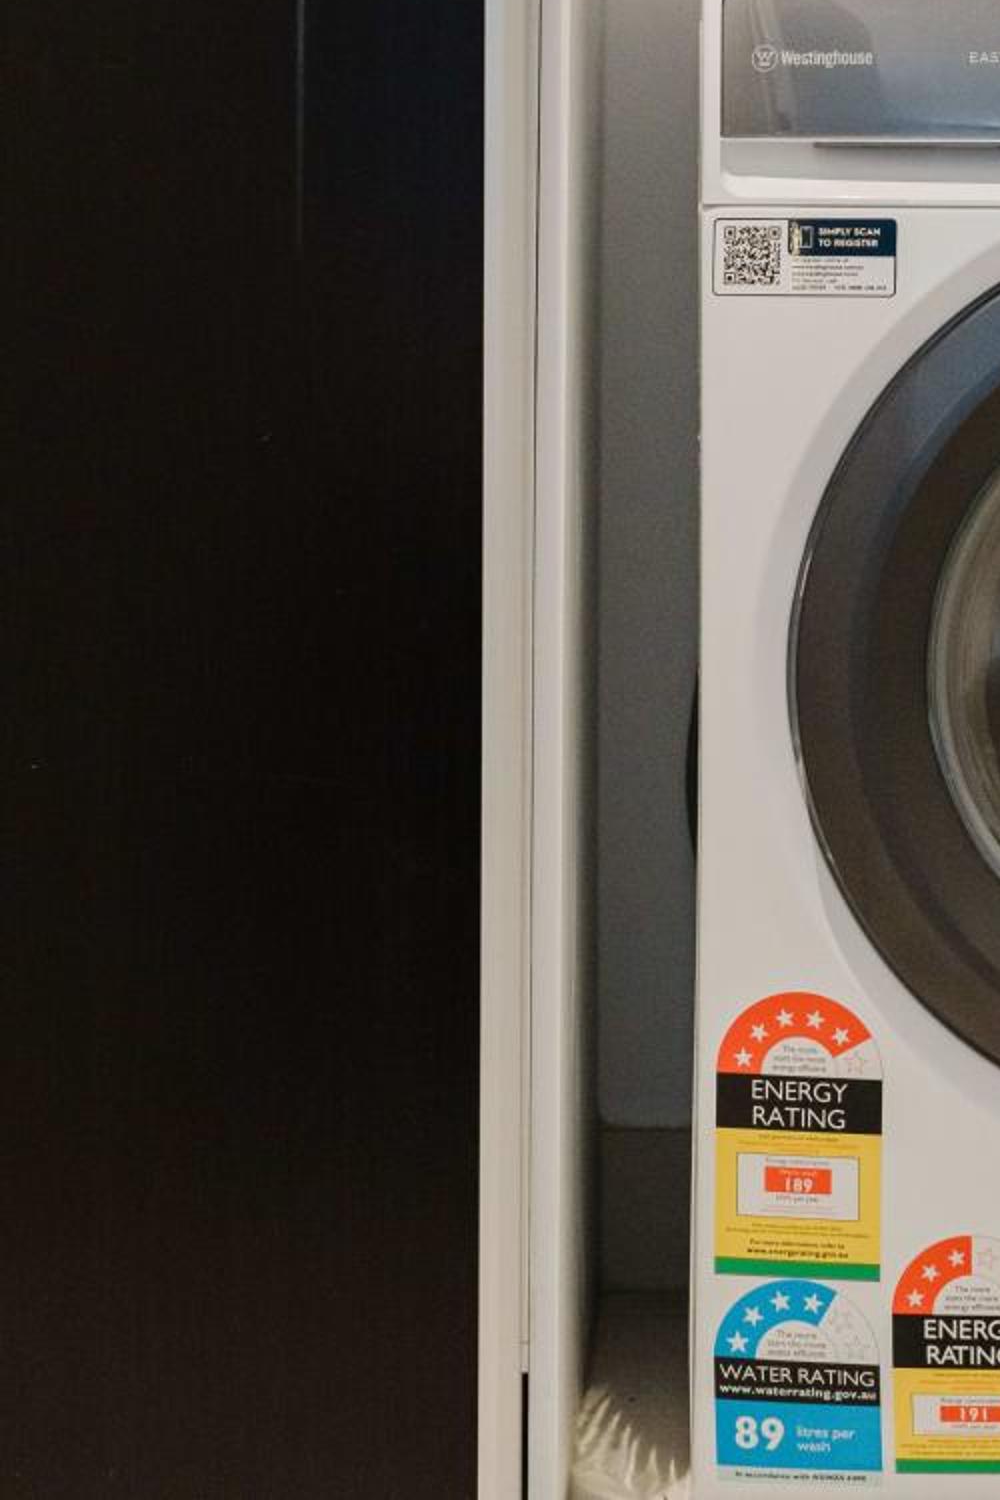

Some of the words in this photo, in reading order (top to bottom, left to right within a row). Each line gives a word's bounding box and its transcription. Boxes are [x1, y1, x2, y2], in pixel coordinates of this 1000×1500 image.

[781, 49, 873, 68] Westinghouse
[818, 227, 851, 236] SIMPLY
[854, 227, 881, 236] SCAN
[818, 238, 832, 247] TO
[834, 238, 879, 248] REGISTER
[751, 1080, 848, 1103] ENERGY
[752, 1105, 846, 1129] RATING
[784, 1177, 814, 1193] 189
[720, 1364, 792, 1384] WATER
[797, 1368, 875, 1387] RATING
[719, 1383, 877, 1401] www.waterrating.gov.au
[960, 1407, 989, 1421] 191
[735, 1415, 785, 1451] 89
[796, 1425, 829, 1439] litres
[832, 1427, 856, 1441] per
[797, 1442, 831, 1453] wash
